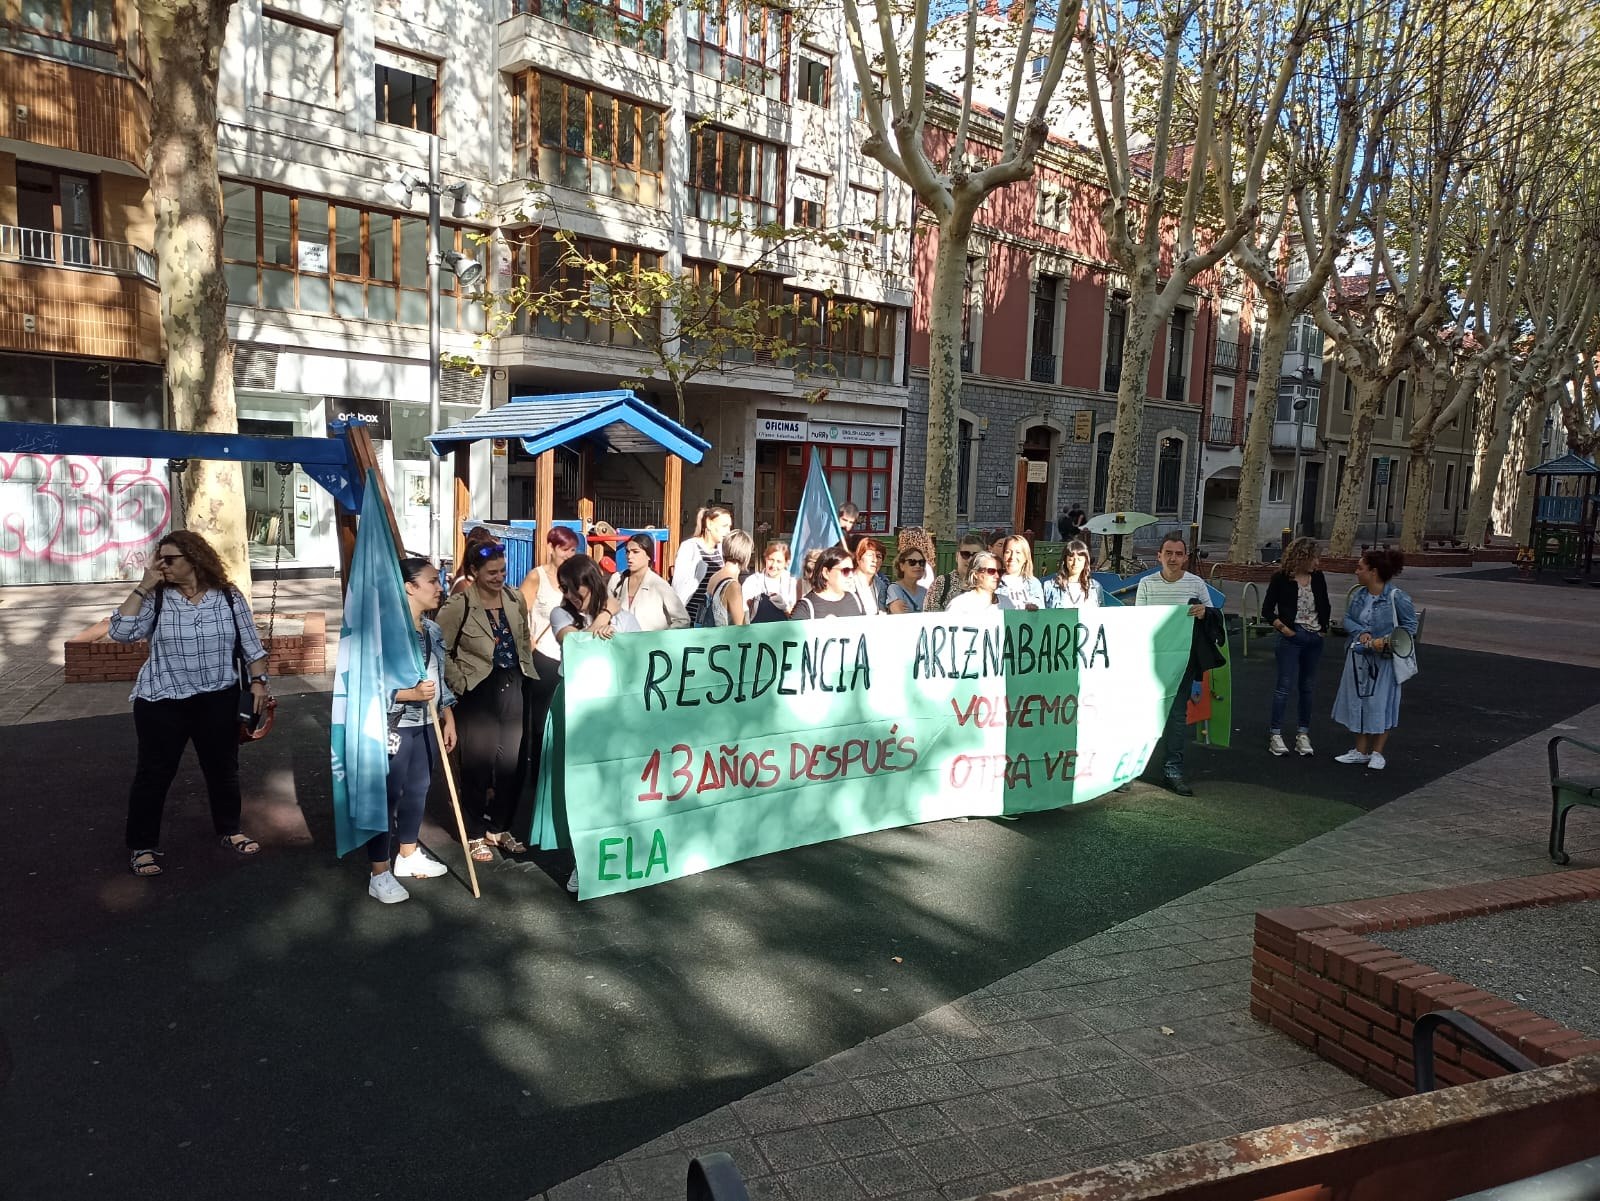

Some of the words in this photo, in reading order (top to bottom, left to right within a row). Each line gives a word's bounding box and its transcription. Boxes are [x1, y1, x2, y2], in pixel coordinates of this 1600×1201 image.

[357, 412, 379, 423] box
[765, 421, 799, 432] OFICINAS
[644, 632, 871, 712] RESIDENCIA
[913, 623, 1110, 680] ARIZNABARRA
[951, 693, 1100, 729] VOLVEMOS
[789, 724, 917, 782] DESPUÉS
[949, 751, 1033, 791] OTRA
[1044, 750, 1097, 782] VEZ
[597, 828, 669, 881] ELA
